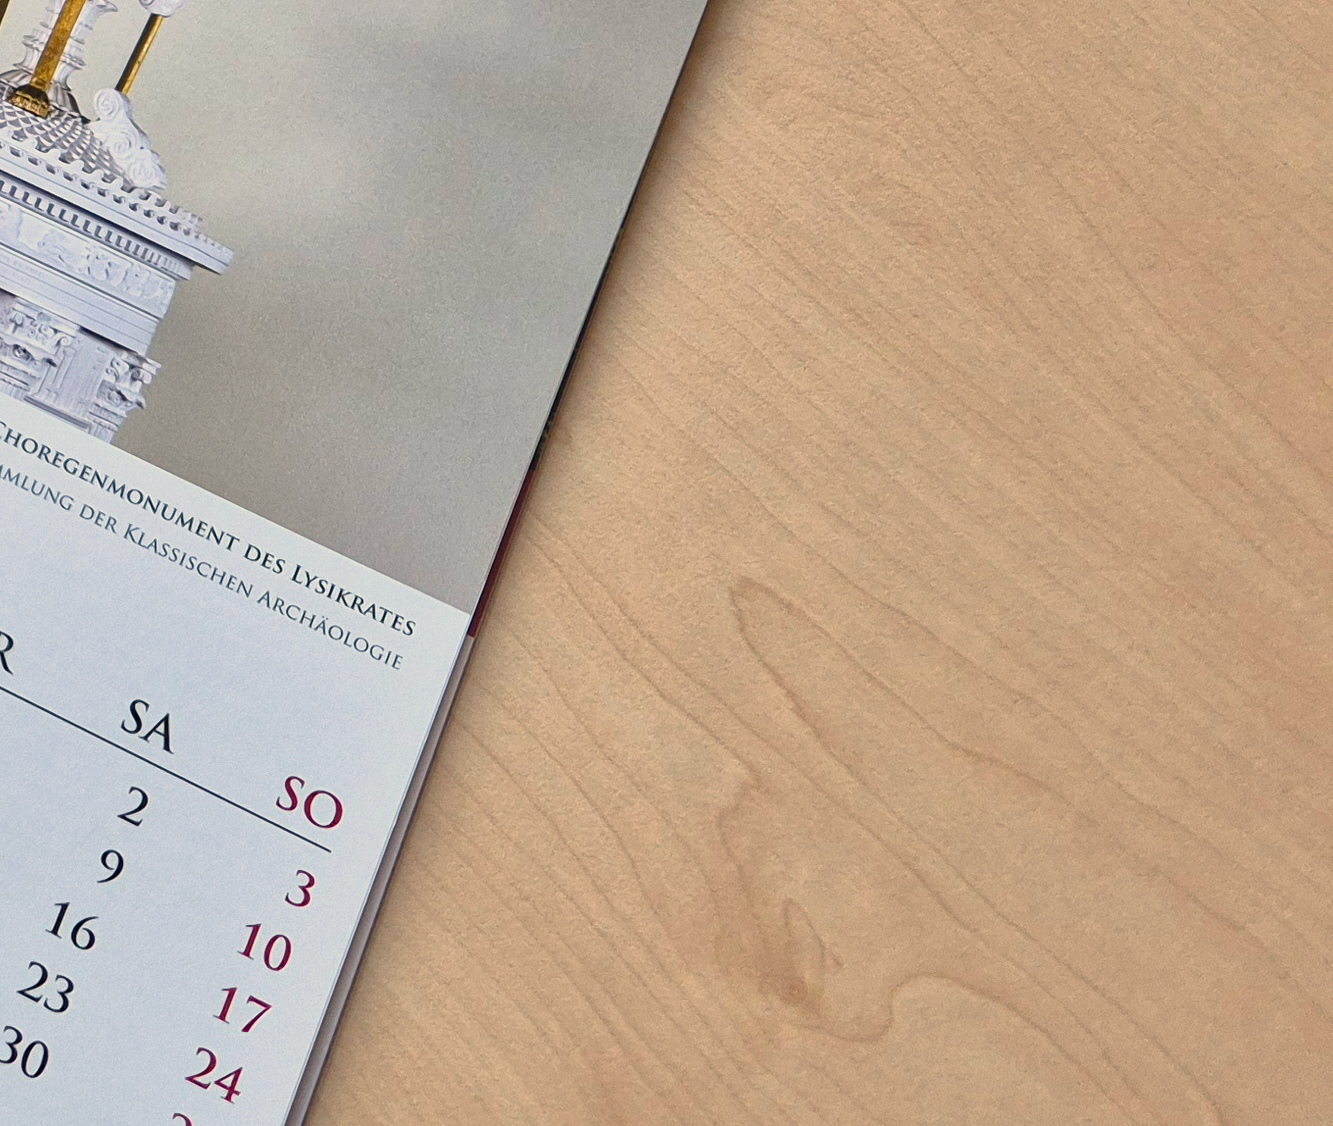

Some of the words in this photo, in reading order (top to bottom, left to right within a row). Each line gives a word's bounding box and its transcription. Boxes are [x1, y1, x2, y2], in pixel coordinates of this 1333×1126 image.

[79, 504, 118, 534] DER
[123, 523, 254, 598] KLASSISCHEN
[256, 590, 404, 671] ARCHÄOLOGIE
[243, 544, 285, 575] DES
[291, 564, 416, 637] LYSIKRATES
[119, 698, 175, 755] SA
[274, 775, 344, 830] SO
[96, 849, 125, 885] 9
[237, 922, 292, 972] 10
[117, 785, 149, 827] 2
[284, 869, 316, 908] 3
[16, 960, 75, 1014] 23
[184, 1046, 244, 1104] 24
[44, 901, 98, 951] 16
[212, 986, 272, 1033] 17
